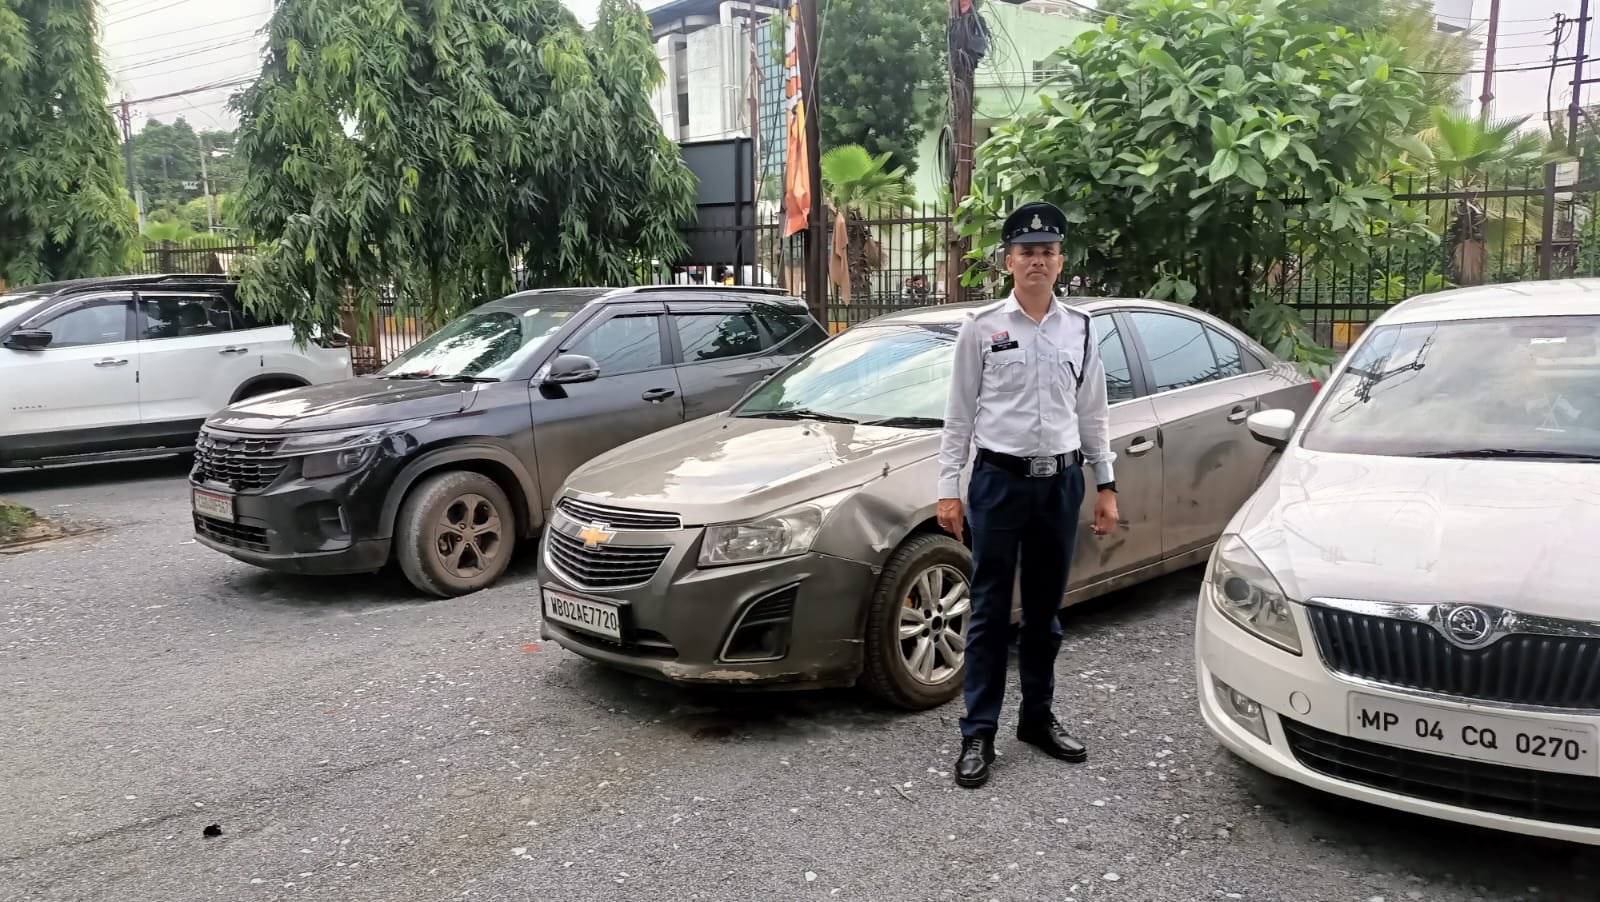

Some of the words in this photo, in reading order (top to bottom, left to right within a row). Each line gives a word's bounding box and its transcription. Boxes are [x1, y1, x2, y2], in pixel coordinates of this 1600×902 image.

[551, 596, 617, 631] WB02AE7720
[1361, 708, 1399, 732] MP
[1415, 718, 1444, 741] 04
[1461, 725, 1498, 750] CQ
[1516, 733, 1580, 761] 0270
